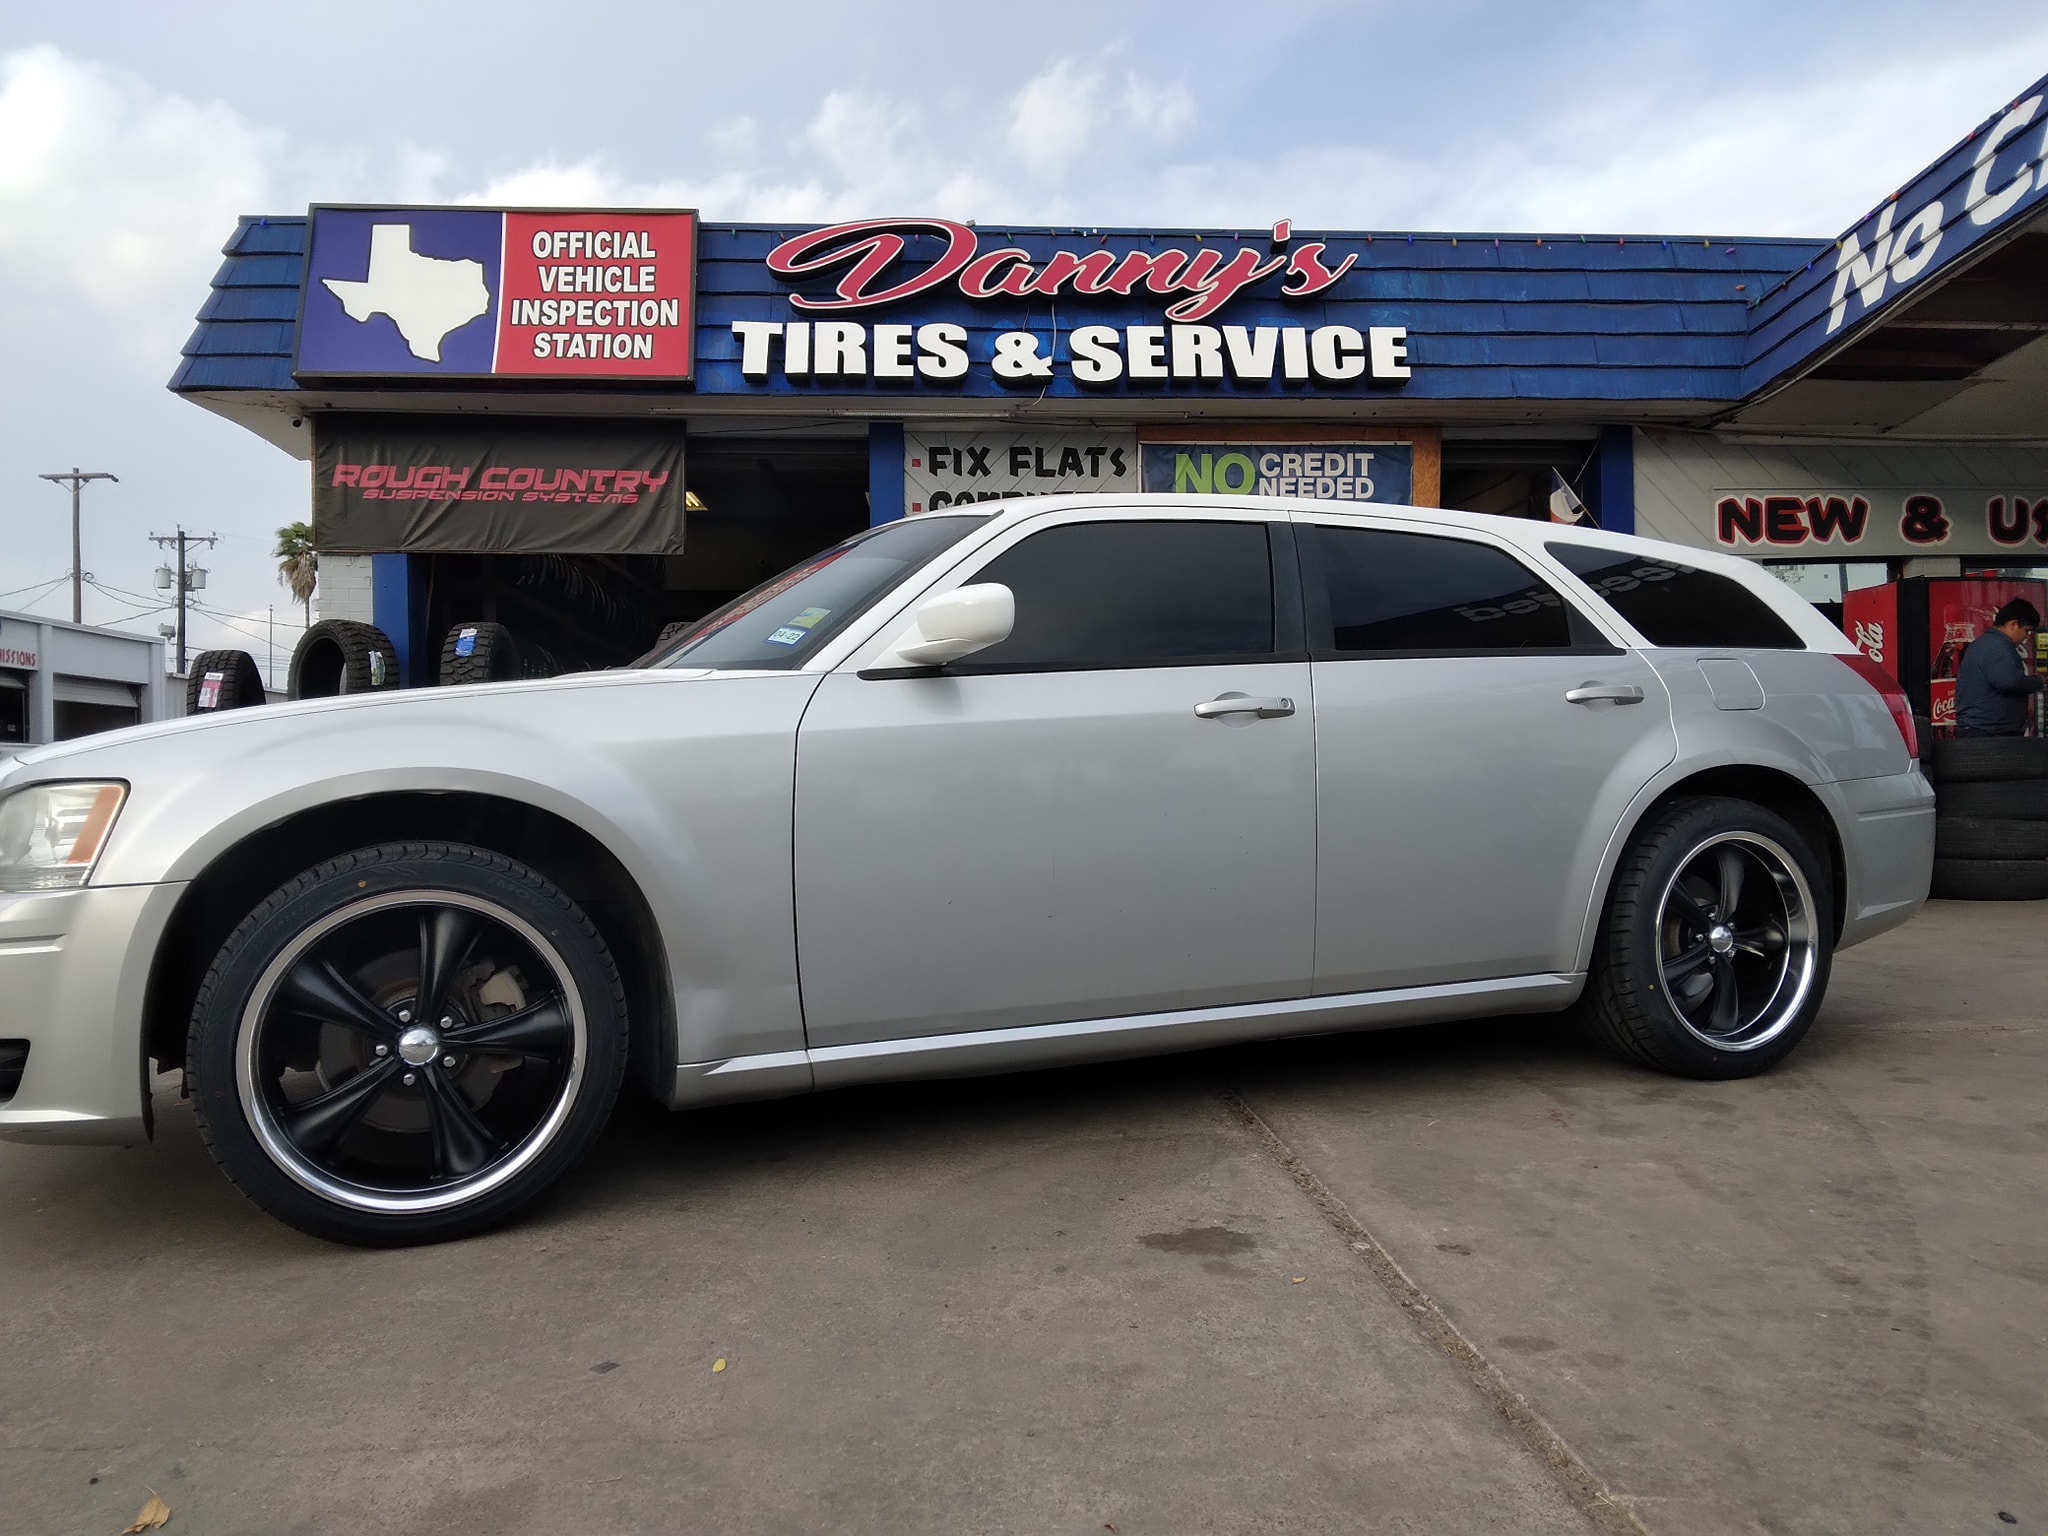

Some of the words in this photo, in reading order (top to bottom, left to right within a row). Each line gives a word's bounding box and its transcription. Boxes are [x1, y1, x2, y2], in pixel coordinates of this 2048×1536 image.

[1826, 200, 1944, 335] No
[1965, 95, 2048, 225] C
[532, 230, 657, 259] OFFICIAL
[538, 265, 656, 293] VEHICLE
[766, 217, 1359, 322] Danny's
[511, 298, 680, 327] INSPECTION
[533, 332, 654, 360] STATION
[731, 320, 969, 379] TIRES
[991, 329, 1054, 380] &
[1068, 325, 1412, 382] SERVICE
[928, 446, 992, 478] FIX
[1010, 446, 1128, 479] FLATS
[1175, 453, 1257, 495] NO
[1259, 453, 1375, 477] CREDIT
[332, 464, 471, 489] ROUGH
[479, 467, 669, 493] COUNTRY
[1258, 477, 1375, 499] NEEDED
[362, 489, 515, 502] SUSPENSION
[521, 491, 640, 504] SYSTEMS
[1717, 495, 1869, 545] NEW
[1901, 495, 1951, 545] &
[0, 648, 36, 667] ISSIONS
